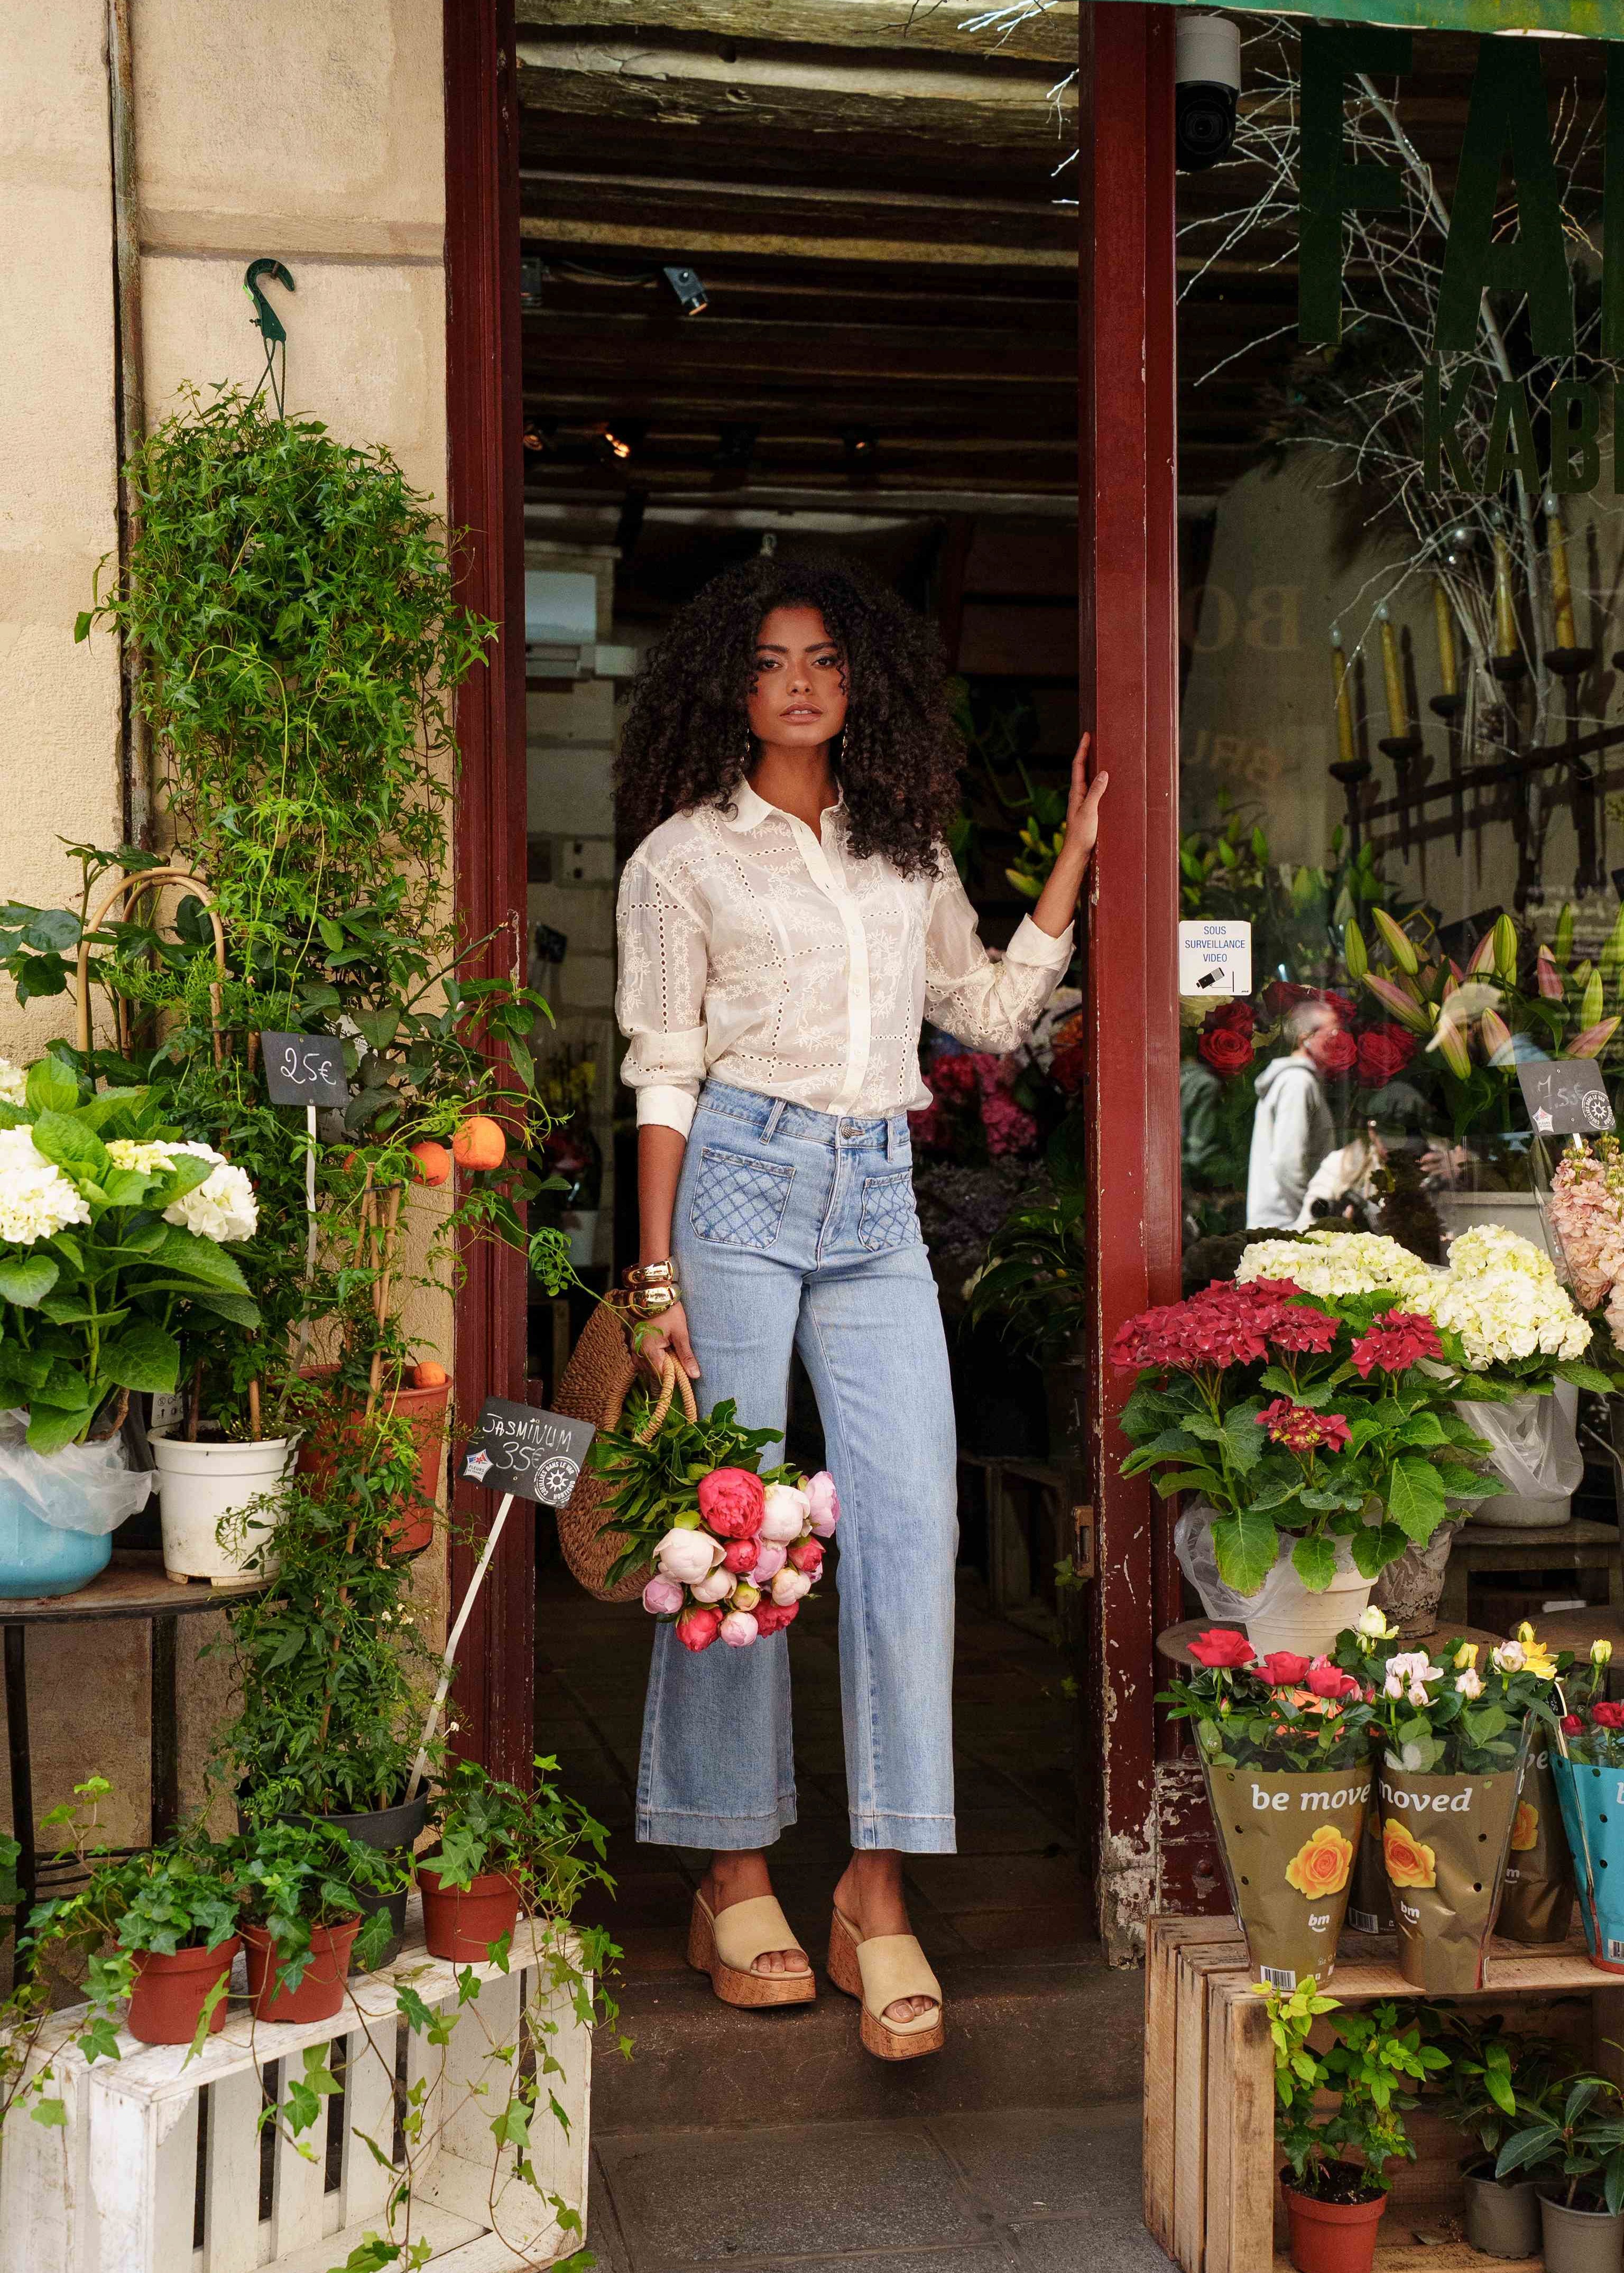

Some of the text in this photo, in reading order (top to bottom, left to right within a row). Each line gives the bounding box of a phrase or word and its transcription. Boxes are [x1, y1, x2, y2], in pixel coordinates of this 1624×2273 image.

[1298, 25, 1624, 358] FA
[1423, 365, 1624, 494] KAB
[1204, 926, 1226, 935] SOUS
[1185, 939, 1245, 949] SURVEILLANCE
[1203, 954, 1227, 962] VIDEO
[280, 1047, 336, 1085] 25€
[482, 1413, 572, 1453] JASMINUM
[538, 1470, 549, 1496] CUEILLIES
[545, 1461, 559, 1472] DANS
[565, 1464, 575, 1475] VAR
[553, 1480, 576, 1500] HORTISUD
[1251, 1784, 1289, 1810] be
[1308, 1914, 1331, 1927] bm
[1400, 1900, 1420, 1918] bm
